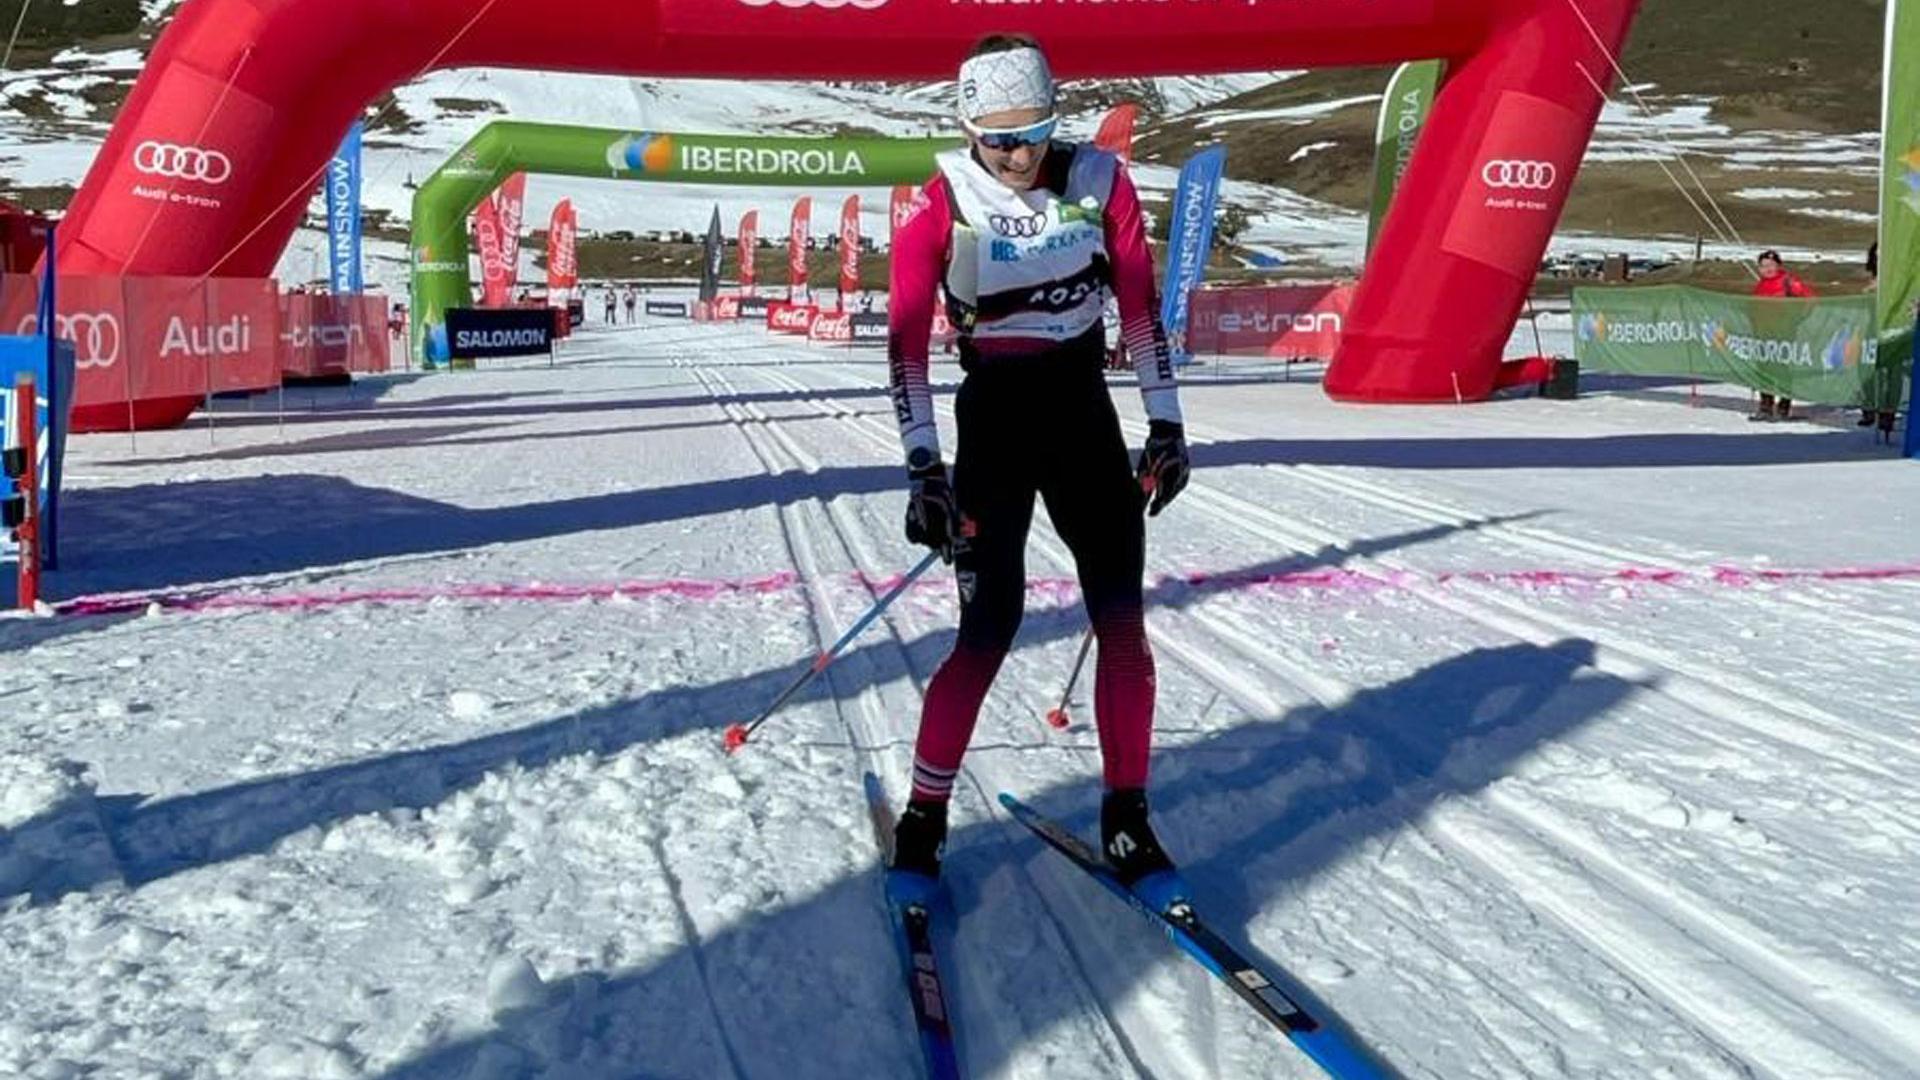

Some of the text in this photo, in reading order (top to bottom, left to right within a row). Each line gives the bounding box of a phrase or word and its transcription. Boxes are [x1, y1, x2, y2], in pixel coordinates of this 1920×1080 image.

[681, 146, 866, 175] IBERDROLA
[132, 185, 168, 200] Audi
[332, 157, 351, 292] PAINSNOW
[1218, 313, 1342, 333] e-tron
[159, 315, 363, 357] Audi -tron
[456, 329, 547, 349] SALOMON
